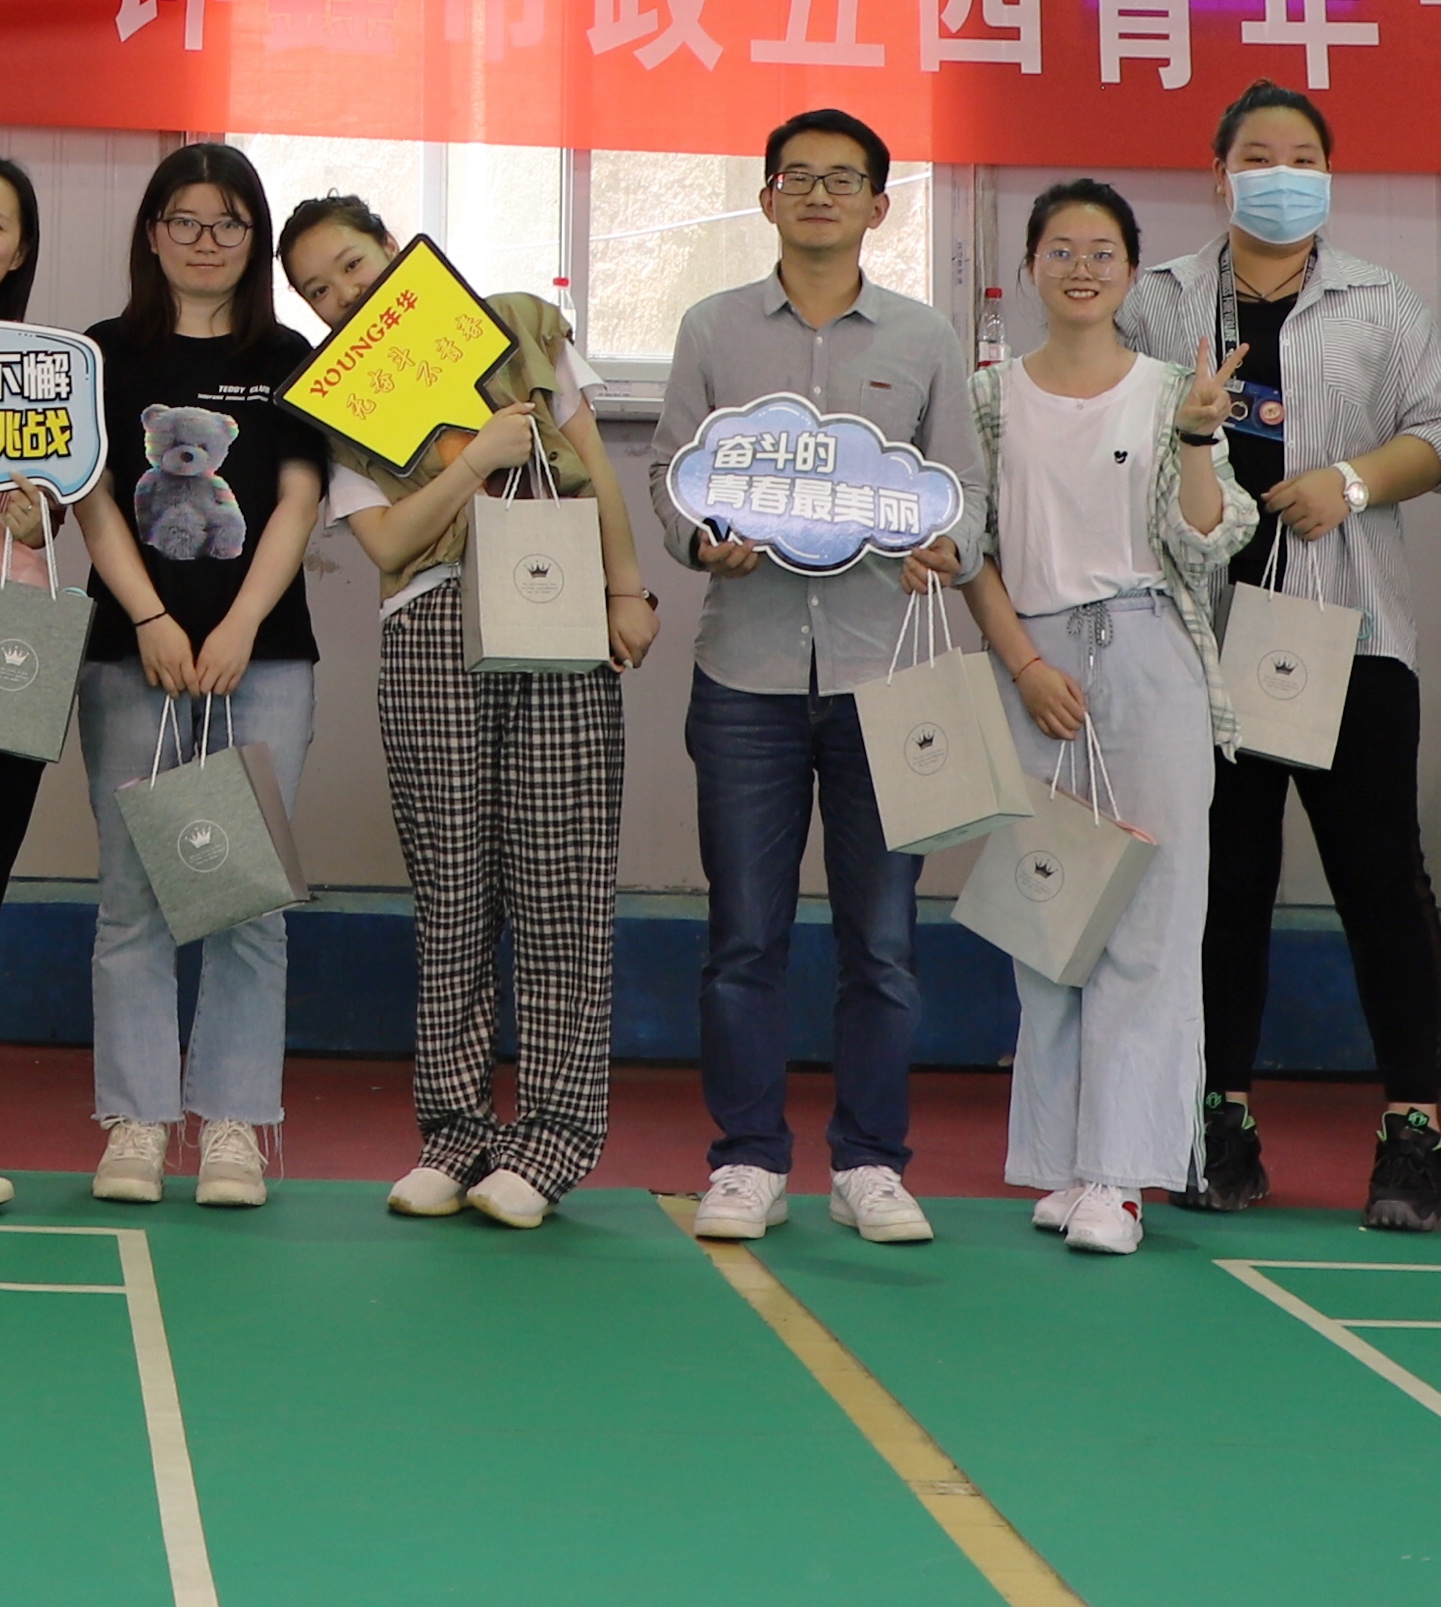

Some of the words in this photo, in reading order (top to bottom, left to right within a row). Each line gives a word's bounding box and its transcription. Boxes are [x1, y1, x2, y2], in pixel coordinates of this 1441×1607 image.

[714, 432, 837, 473] 奋斗的
[706, 474, 920, 534] 青春最美丽
